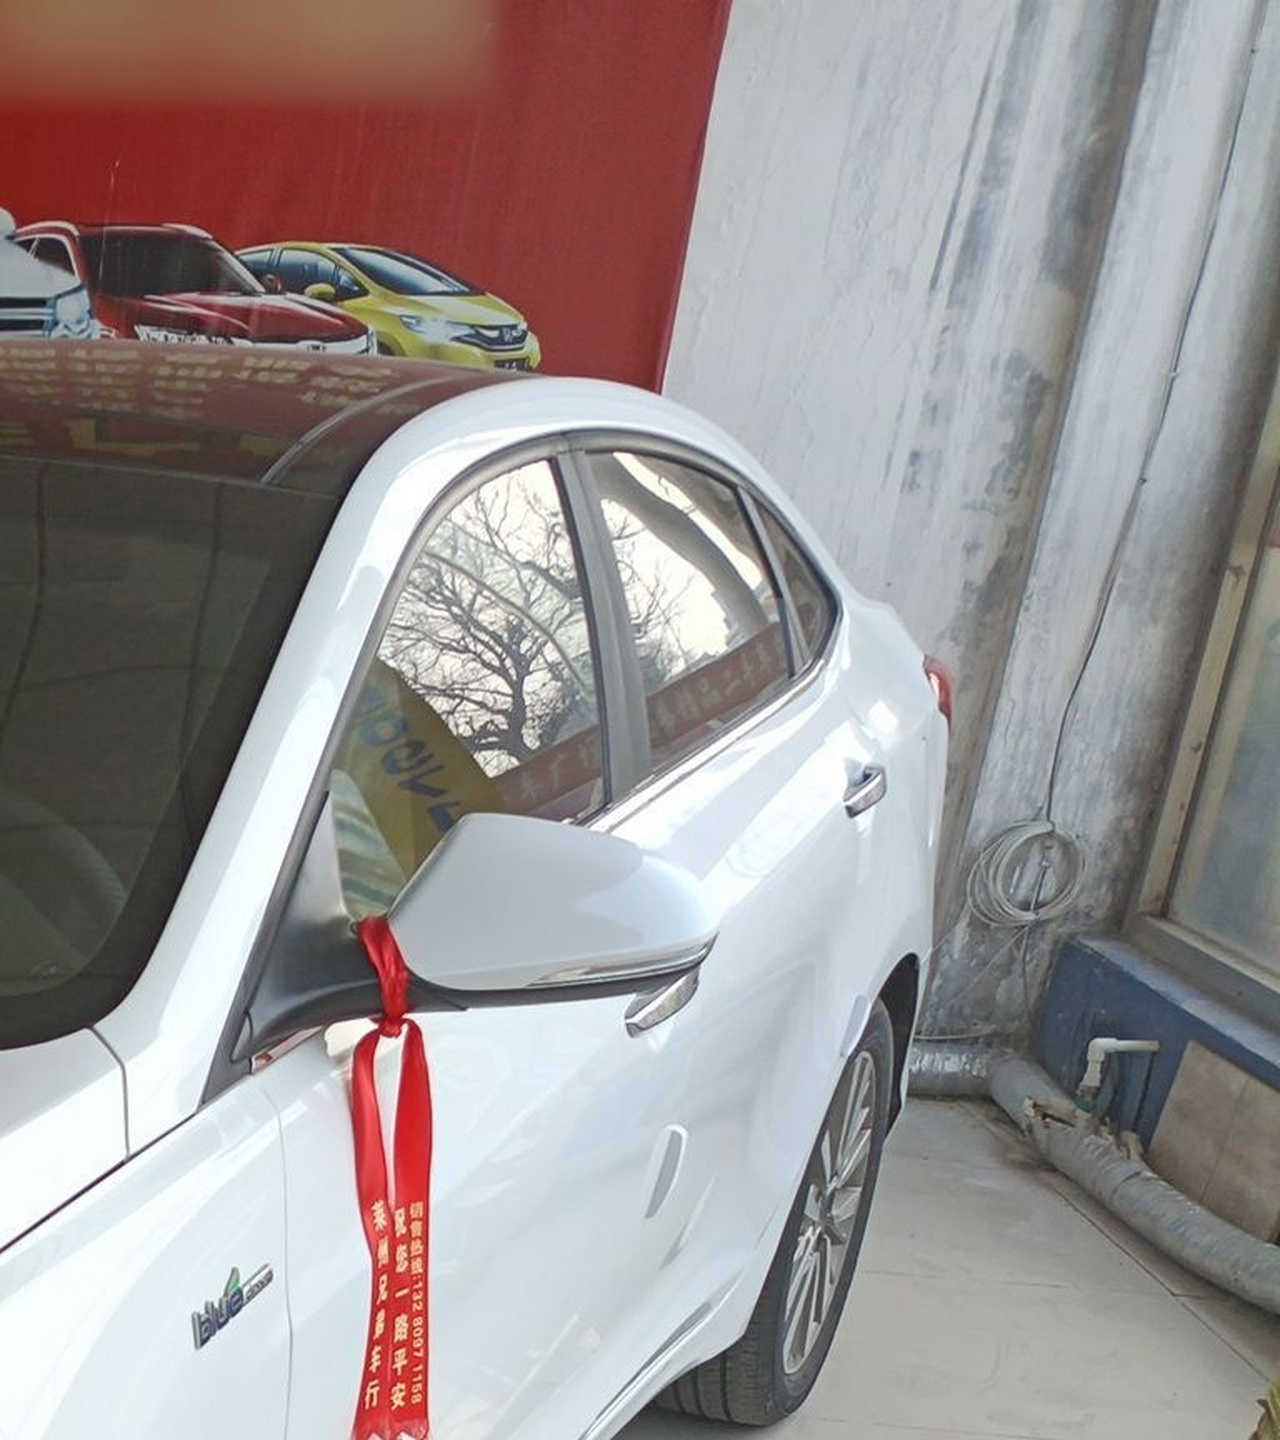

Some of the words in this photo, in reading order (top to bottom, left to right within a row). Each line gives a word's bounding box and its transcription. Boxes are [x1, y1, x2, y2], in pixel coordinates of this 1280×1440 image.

[390, 1207, 410, 1411] 祝您一路平安
[411, 1364, 423, 1404] 1158
